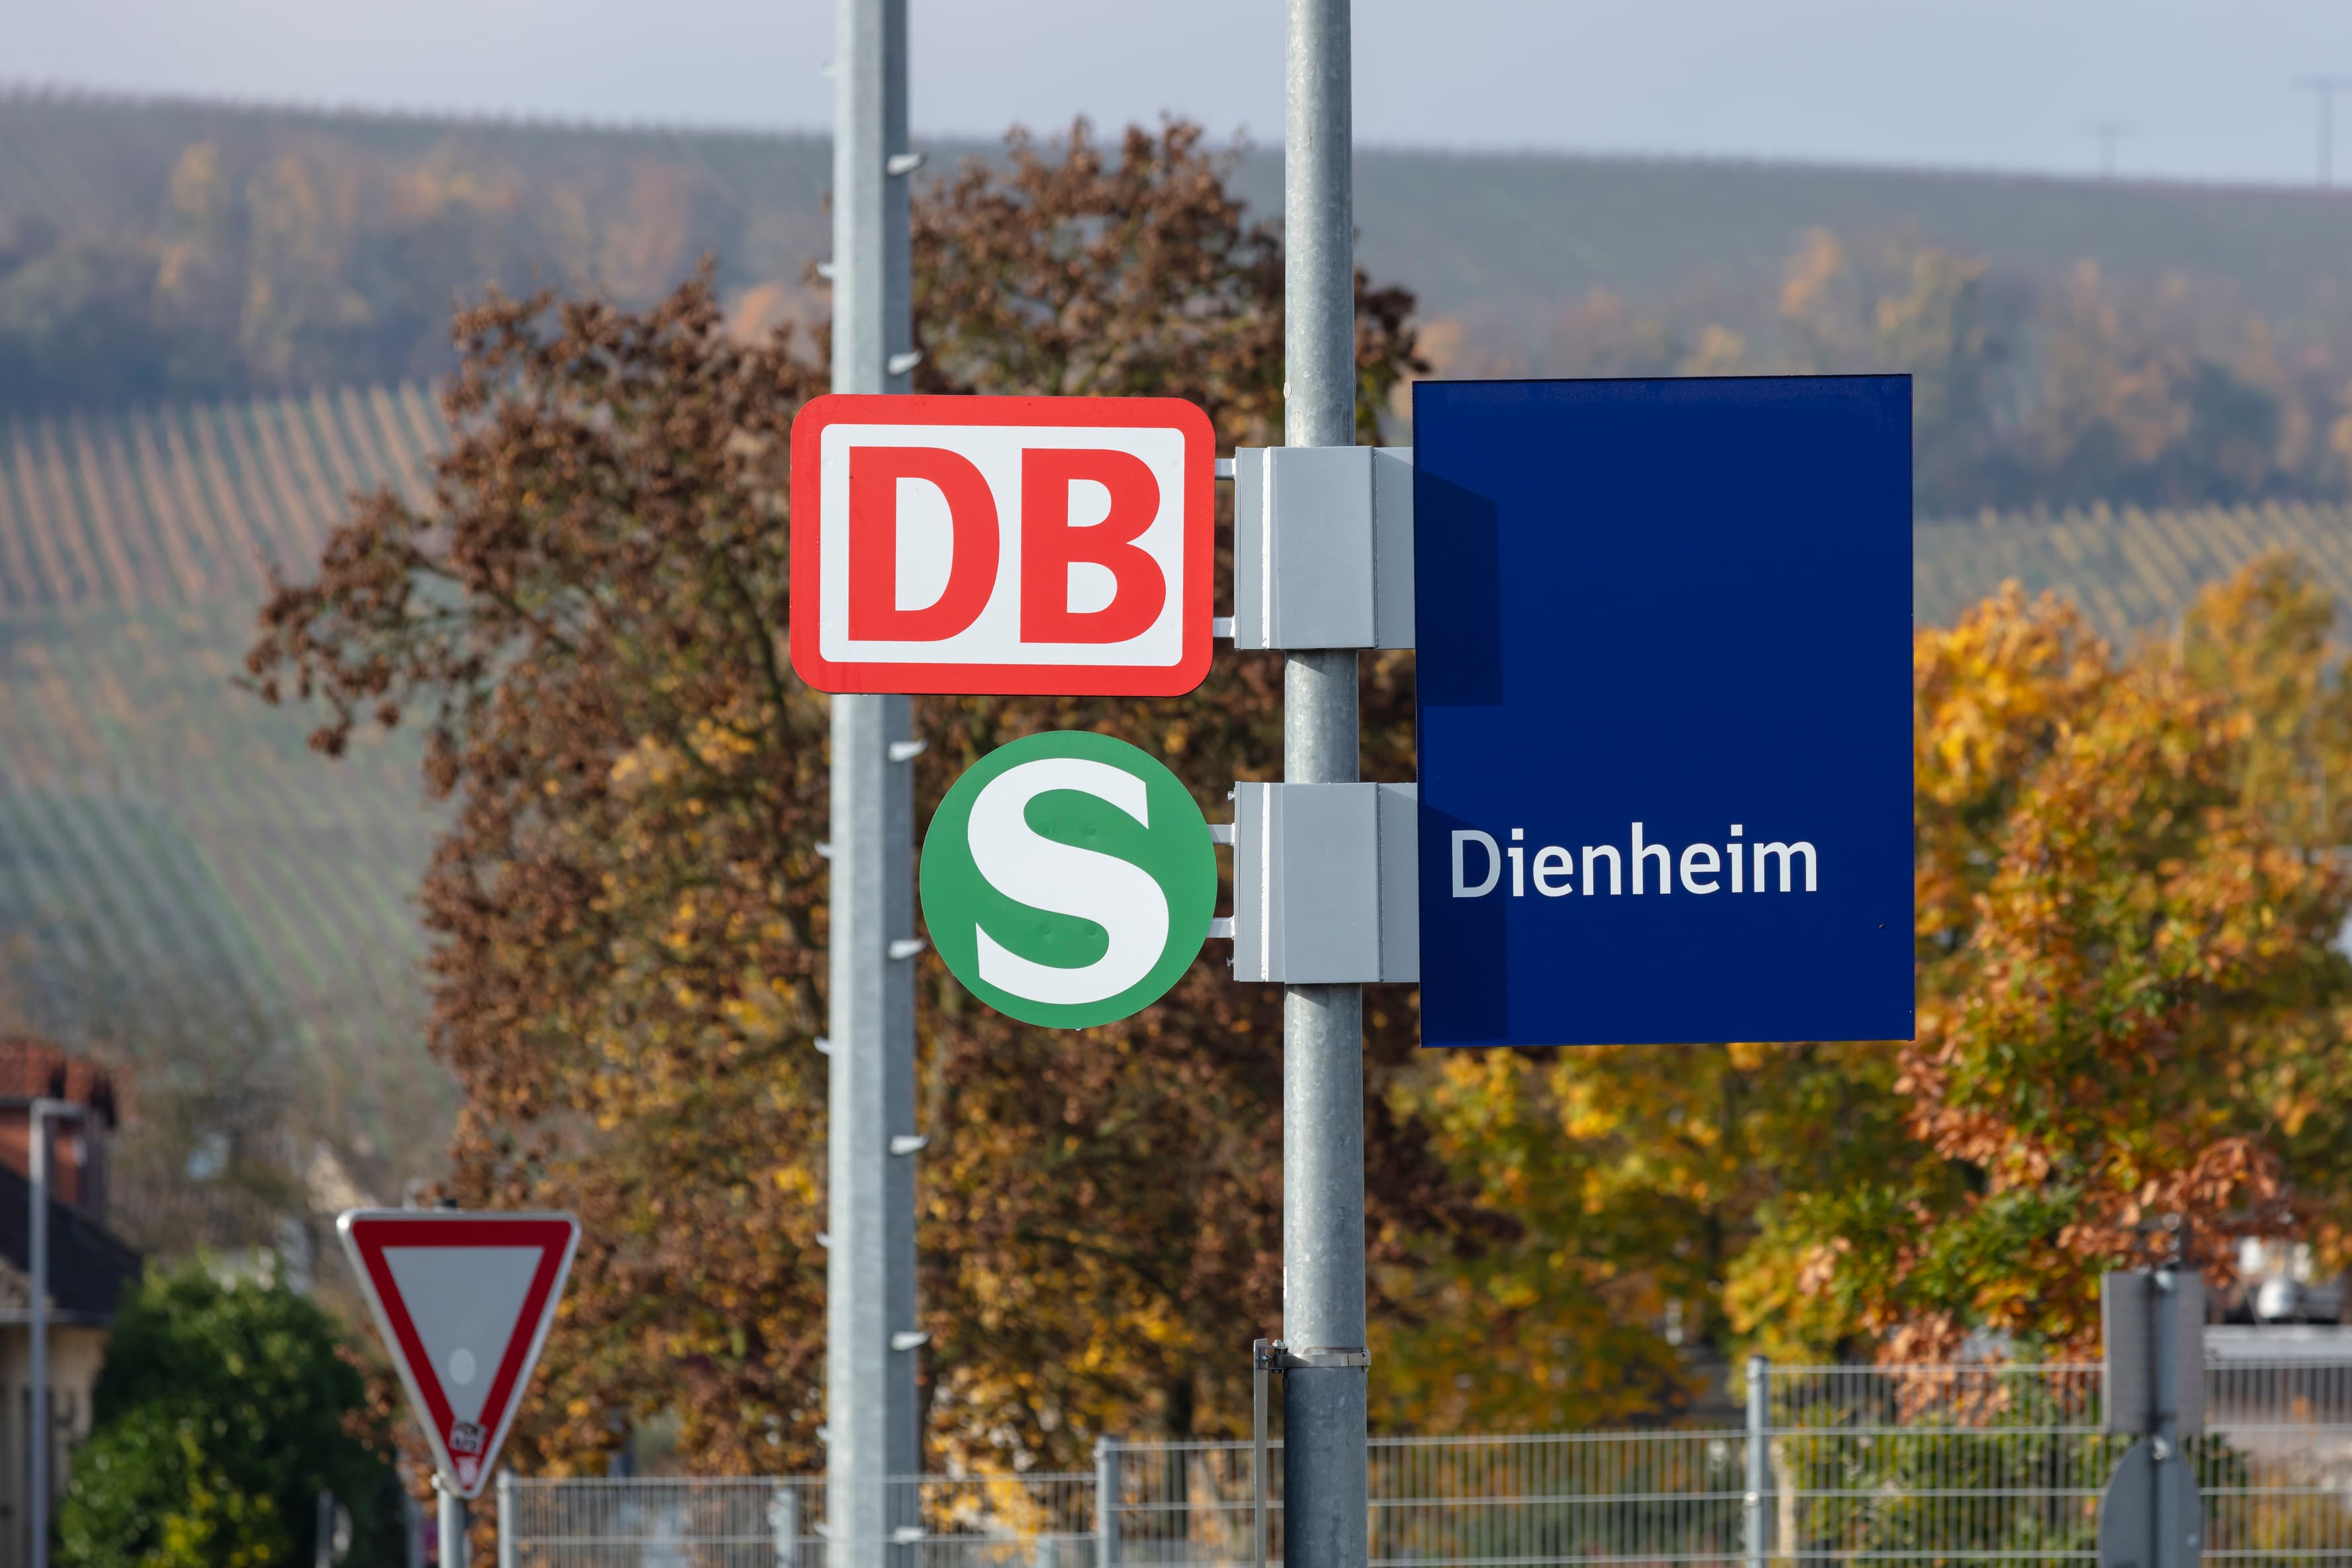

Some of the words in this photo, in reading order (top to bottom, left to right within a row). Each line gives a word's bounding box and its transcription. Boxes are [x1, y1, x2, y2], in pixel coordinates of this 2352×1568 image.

[848, 446, 1166, 644] DB
[967, 758, 1170, 1005] S
[1452, 822, 1817, 898] Dienheim
